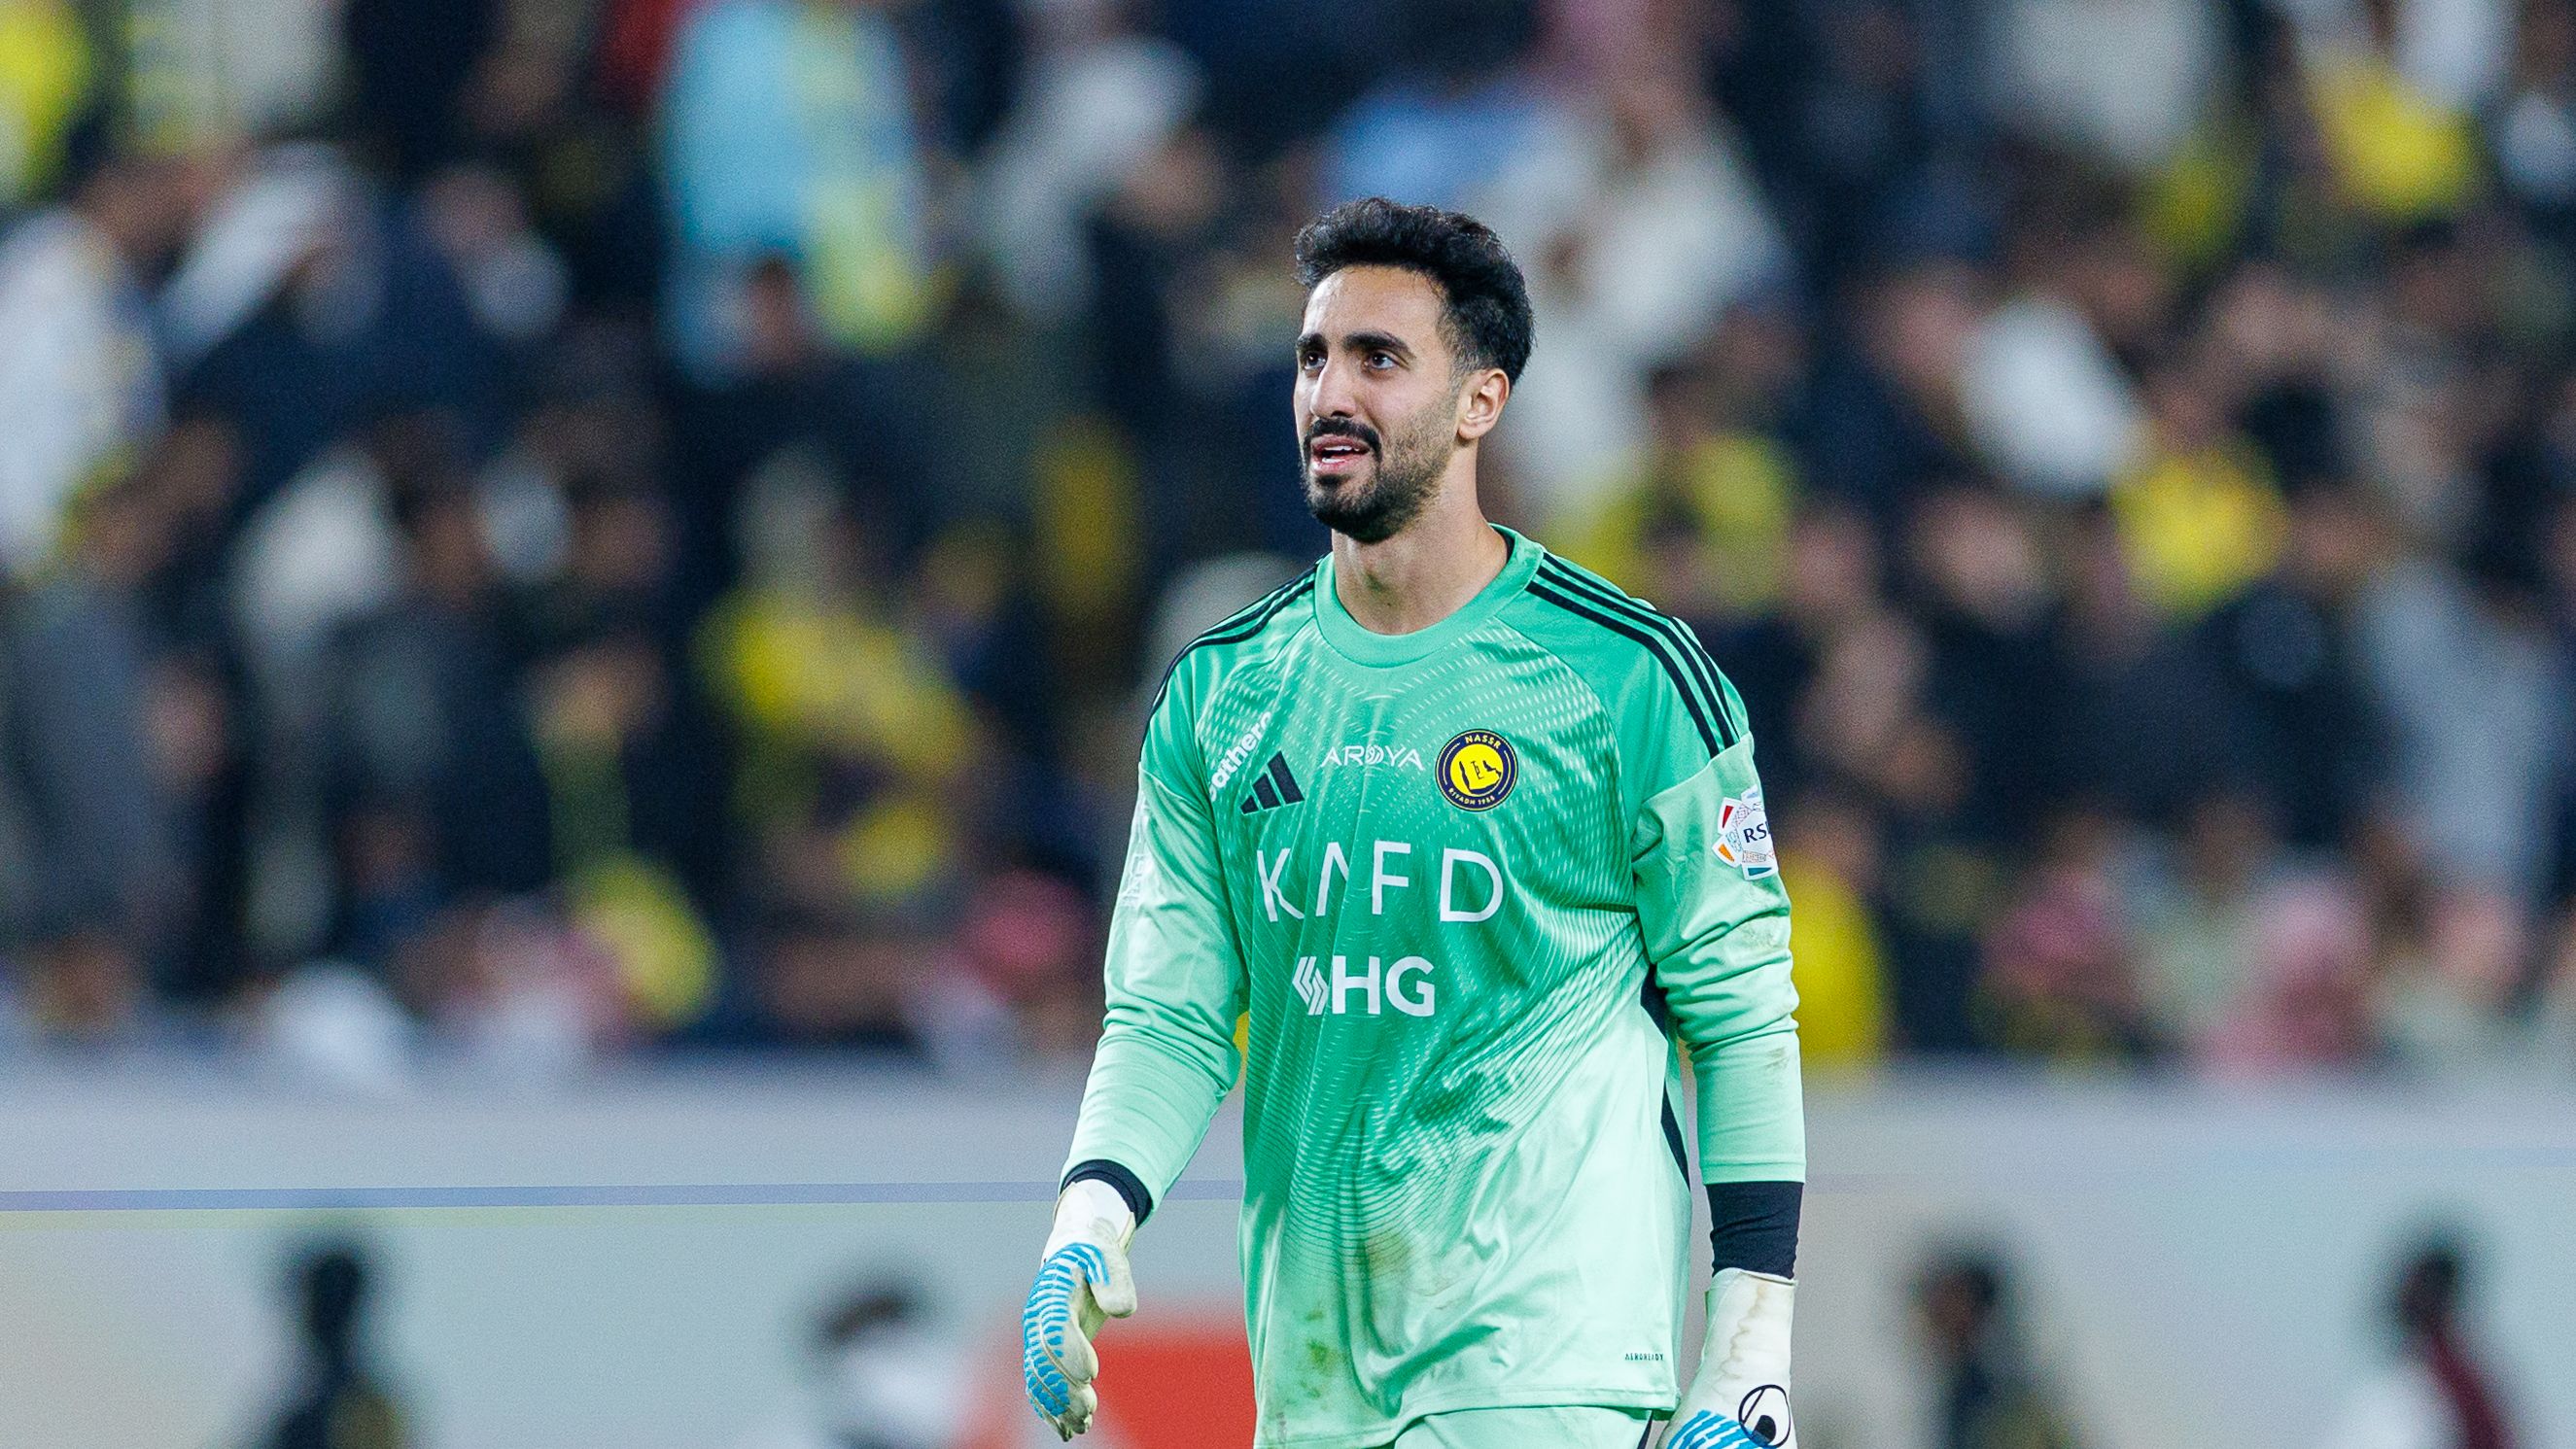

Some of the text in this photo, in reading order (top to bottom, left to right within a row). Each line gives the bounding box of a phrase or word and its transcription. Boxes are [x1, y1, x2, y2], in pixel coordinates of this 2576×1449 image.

[1465, 735, 1502, 748] NASSR
[1320, 744, 1424, 771] AROYA
[1331, 956, 1435, 1017] HG
